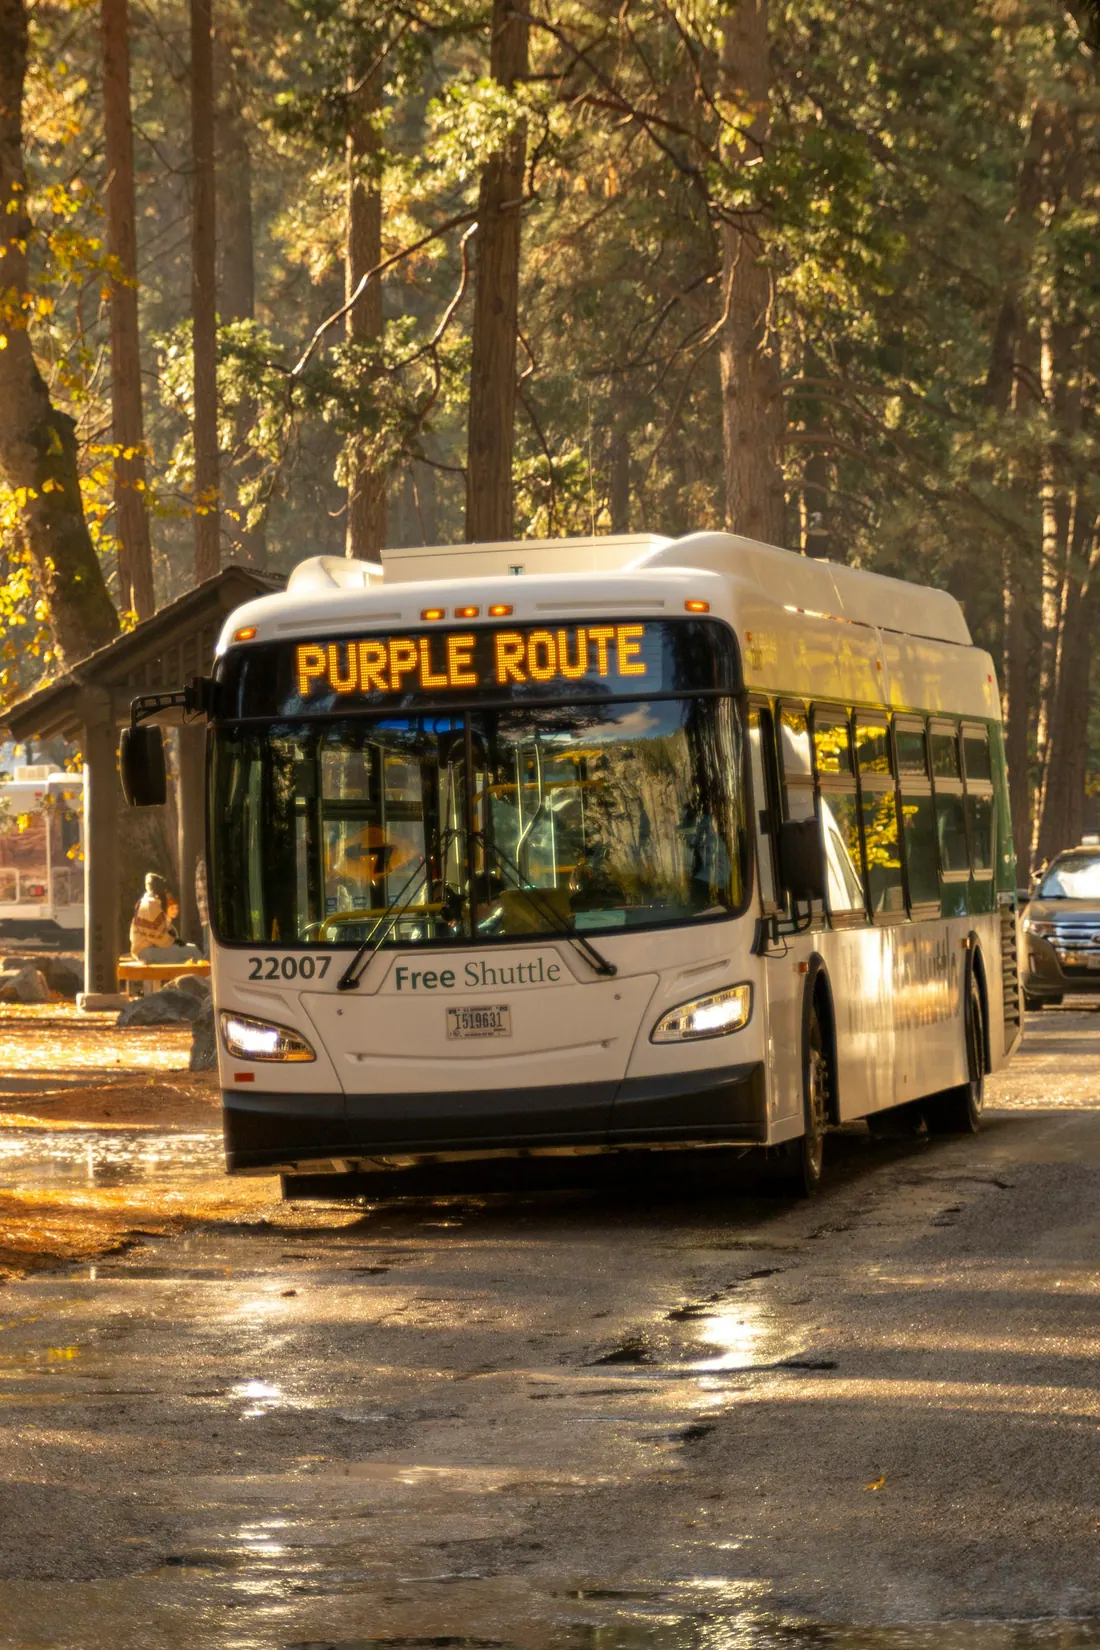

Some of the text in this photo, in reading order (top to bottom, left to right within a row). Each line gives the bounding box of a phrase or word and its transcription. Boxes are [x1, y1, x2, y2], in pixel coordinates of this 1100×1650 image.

[296, 624, 646, 694] PURPLE ROUTE
[248, 956, 332, 980] 22007
[395, 957, 561, 991] Free Shuttle
